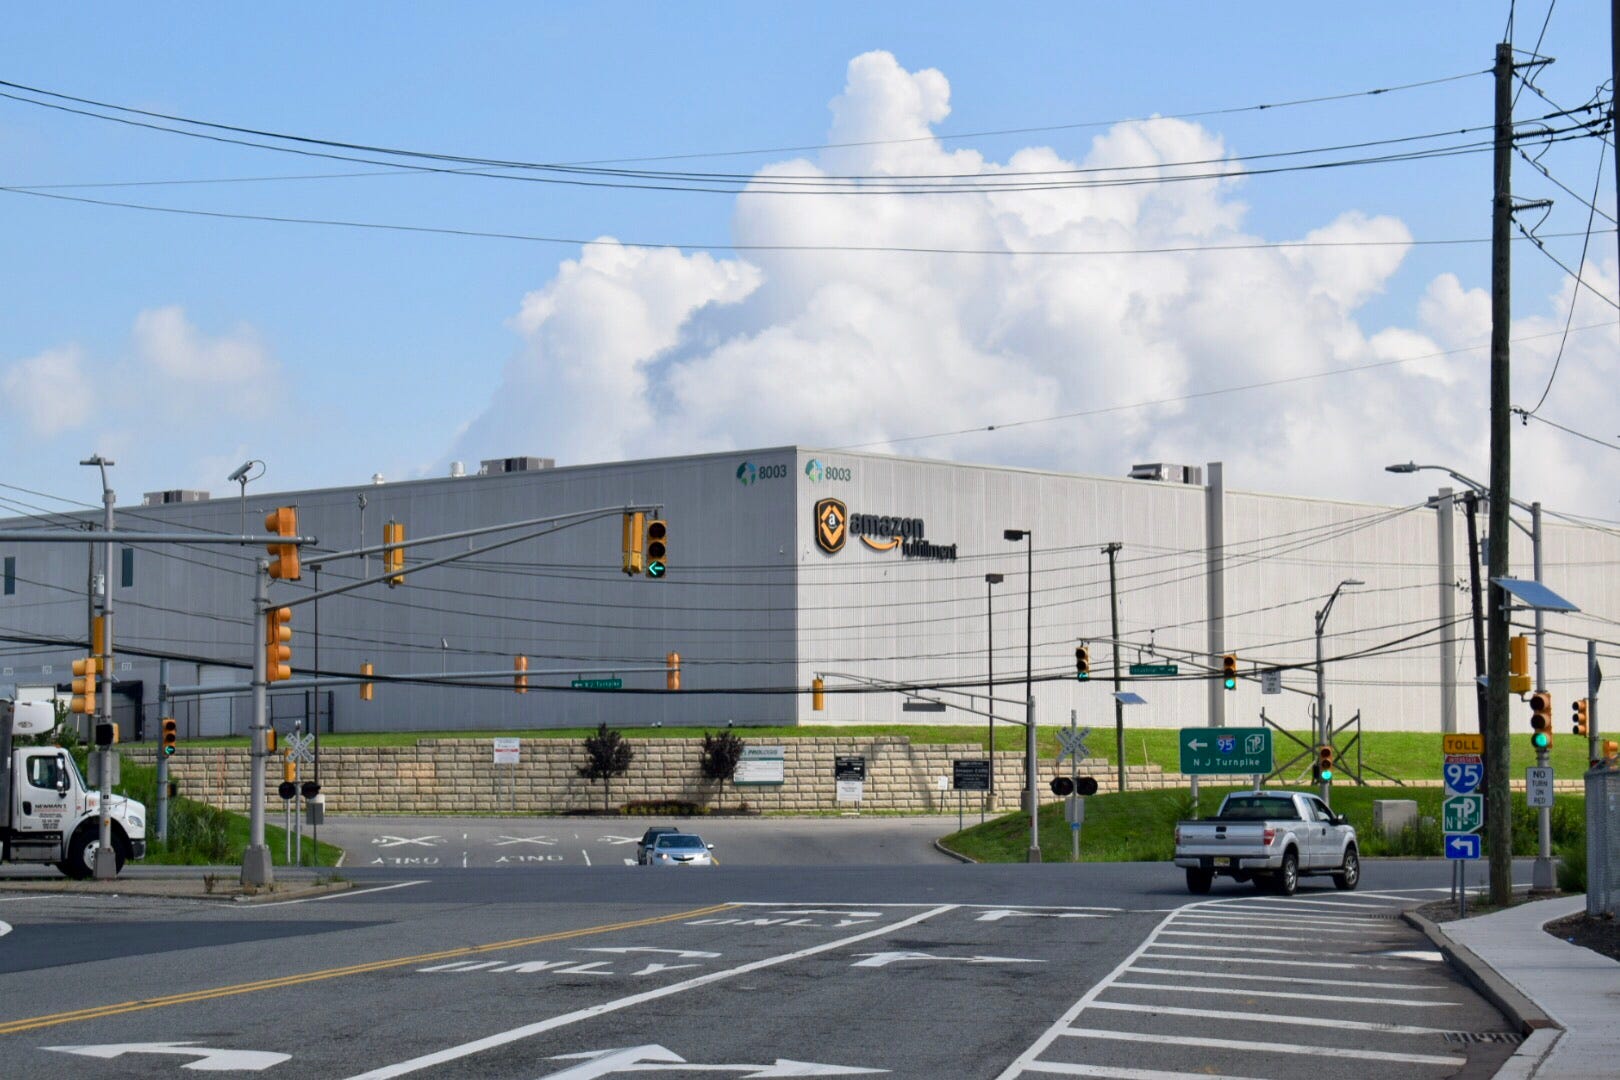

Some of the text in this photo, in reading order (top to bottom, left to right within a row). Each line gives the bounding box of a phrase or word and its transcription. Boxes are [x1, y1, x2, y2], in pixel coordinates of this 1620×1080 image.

[759, 465, 787, 480] 8003
[825, 466, 851, 482] 8003
[849, 513, 925, 539] amazon
[901, 539, 957, 563] fulfillment
[1217, 740, 1233, 751] 95
[1447, 740, 1479, 750] TOLL
[1193, 758, 1260, 767] N J Turnpike
[1446, 764, 1479, 787] 95
[683, 918, 876, 927] ONLY
[415, 960, 703, 975] ONLY
